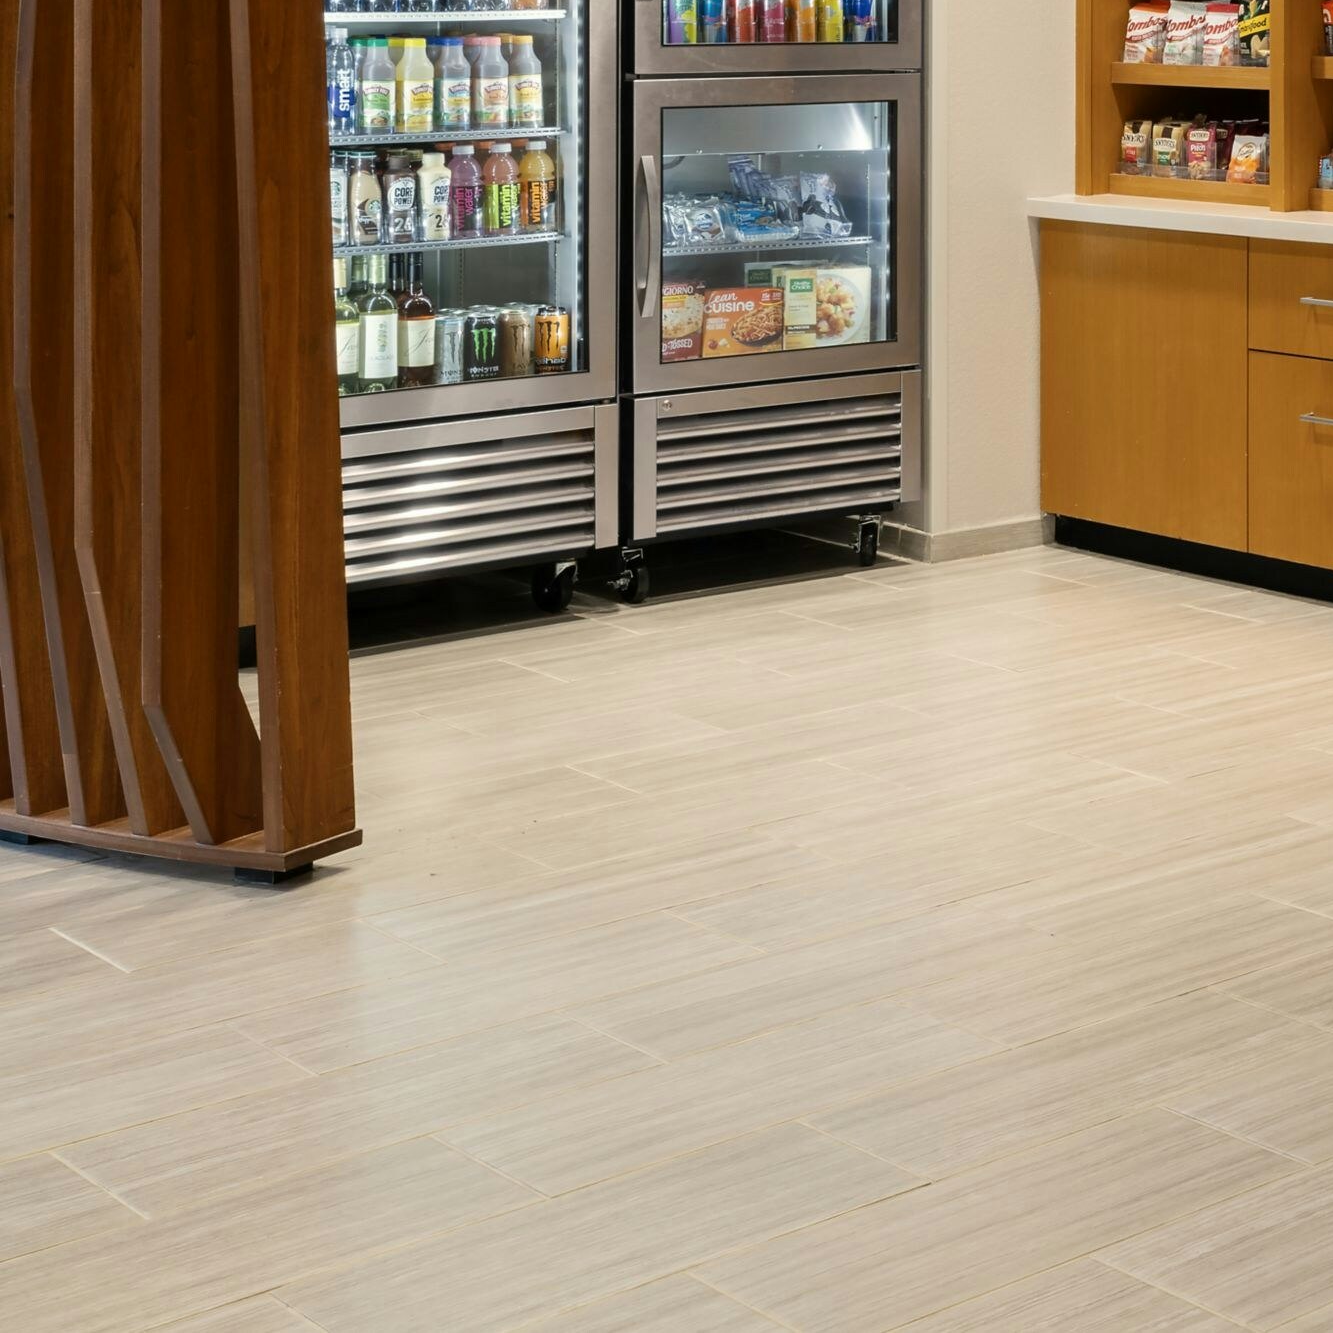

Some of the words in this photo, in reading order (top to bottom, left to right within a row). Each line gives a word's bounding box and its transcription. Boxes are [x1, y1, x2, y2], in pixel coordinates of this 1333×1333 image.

[395, 187, 413, 198] CORE
[434, 185, 448, 195] COR
[394, 197, 412, 205] POWE
[465, 188, 474, 216] water
[500, 184, 511, 226] vitamin
[529, 182, 541, 223] vitamin
[662, 285, 694, 296] GIORNO
[709, 291, 738, 304] Lean
